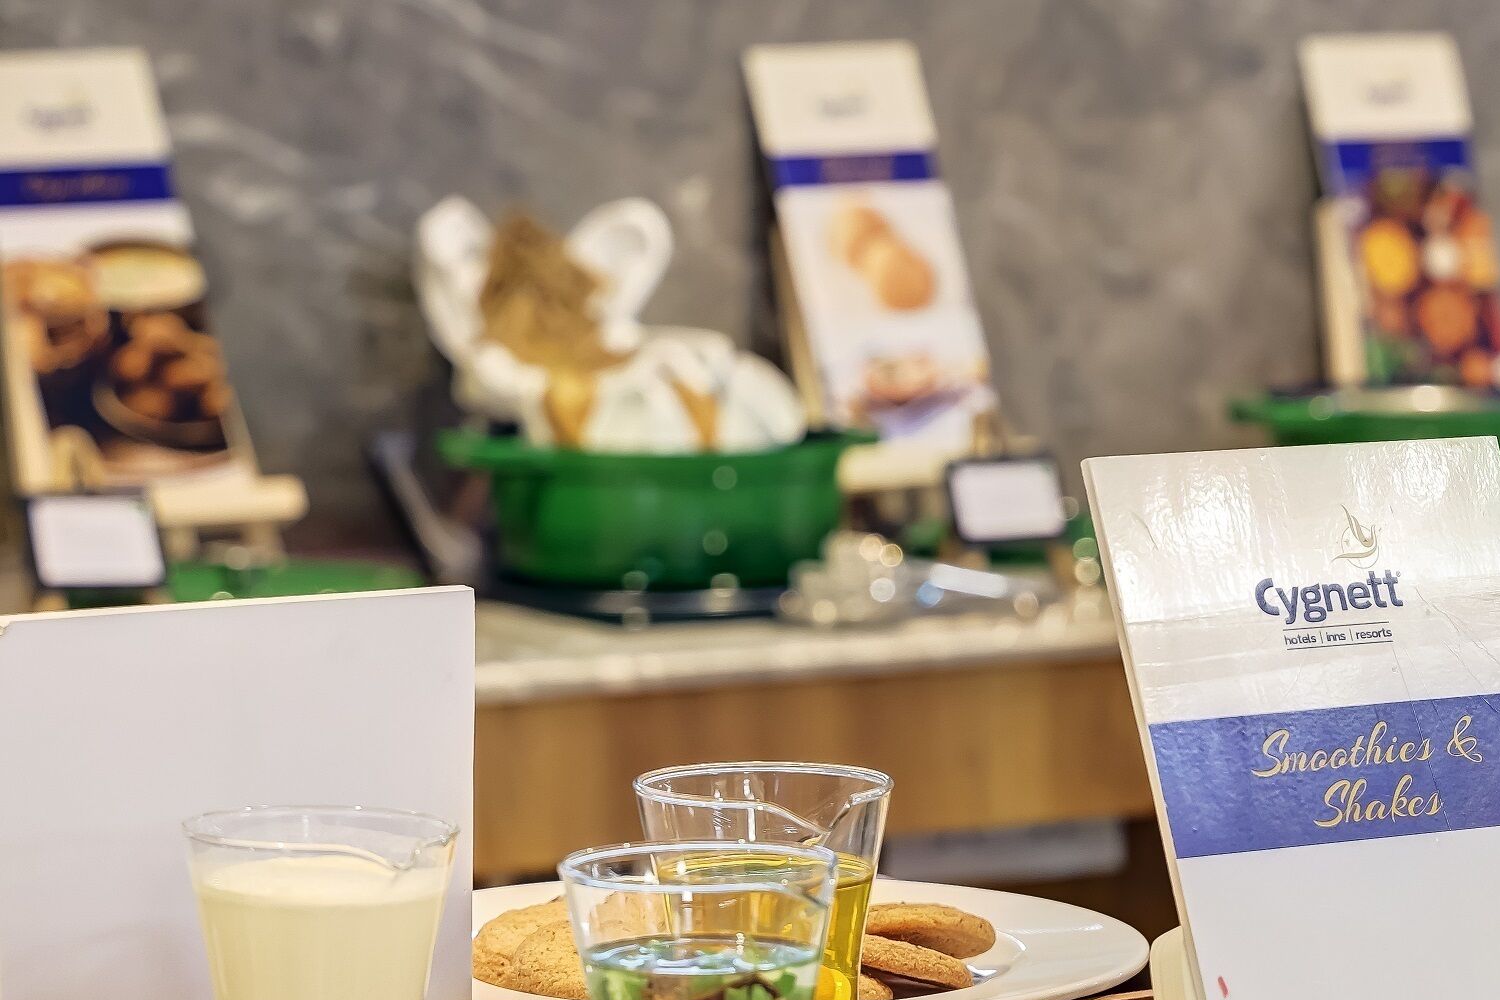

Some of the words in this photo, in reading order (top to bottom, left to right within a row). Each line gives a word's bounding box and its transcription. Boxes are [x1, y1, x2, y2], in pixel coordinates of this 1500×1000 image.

[1254, 569, 1404, 625] Cygnett
[1284, 631, 1317, 646] hotels
[1326, 631, 1346, 643] inns
[1355, 627, 1393, 640] resorts
[1251, 719, 1435, 779] Smoothies
[1446, 714, 1484, 764] &
[1313, 774, 1443, 828] Shakes
